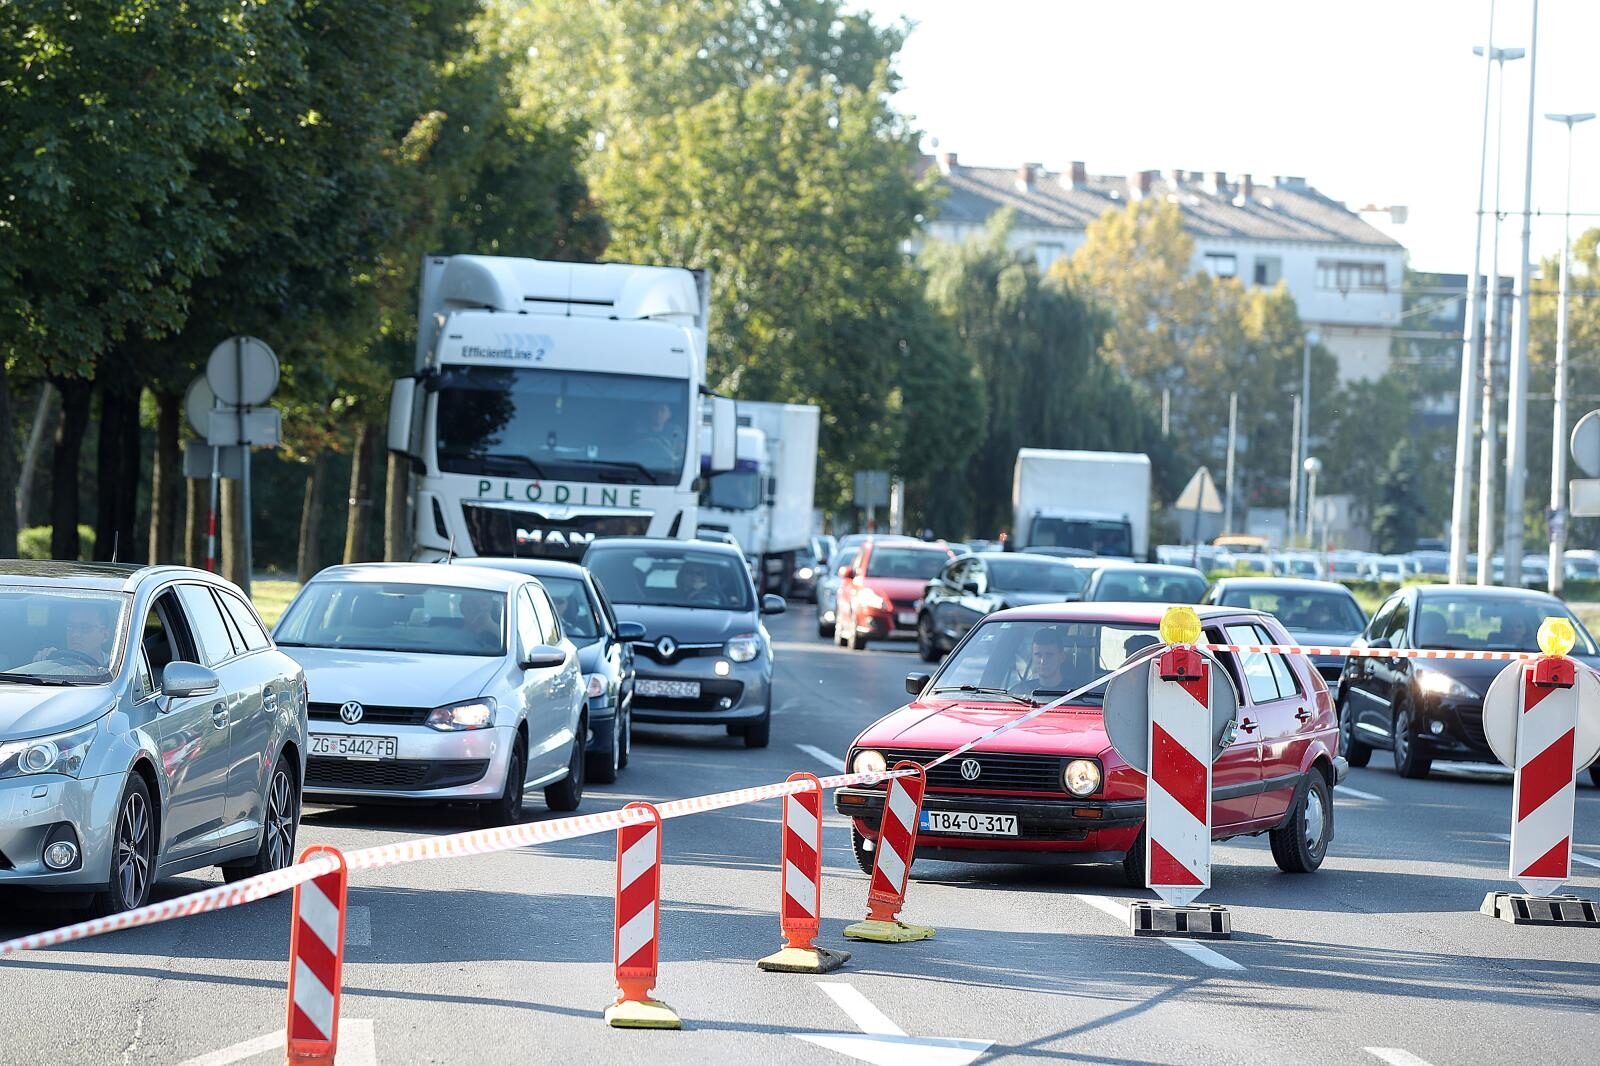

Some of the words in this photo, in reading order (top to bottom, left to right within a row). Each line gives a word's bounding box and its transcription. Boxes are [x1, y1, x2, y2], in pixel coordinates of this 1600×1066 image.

[462, 346, 532, 360] EfficientLine
[535, 348, 545, 361] 2
[478, 480, 641, 507] PLODINE
[516, 528, 596, 548] MAN
[312, 737, 329, 753] ZG
[339, 739, 374, 754] 5442
[377, 740, 394, 756] FB
